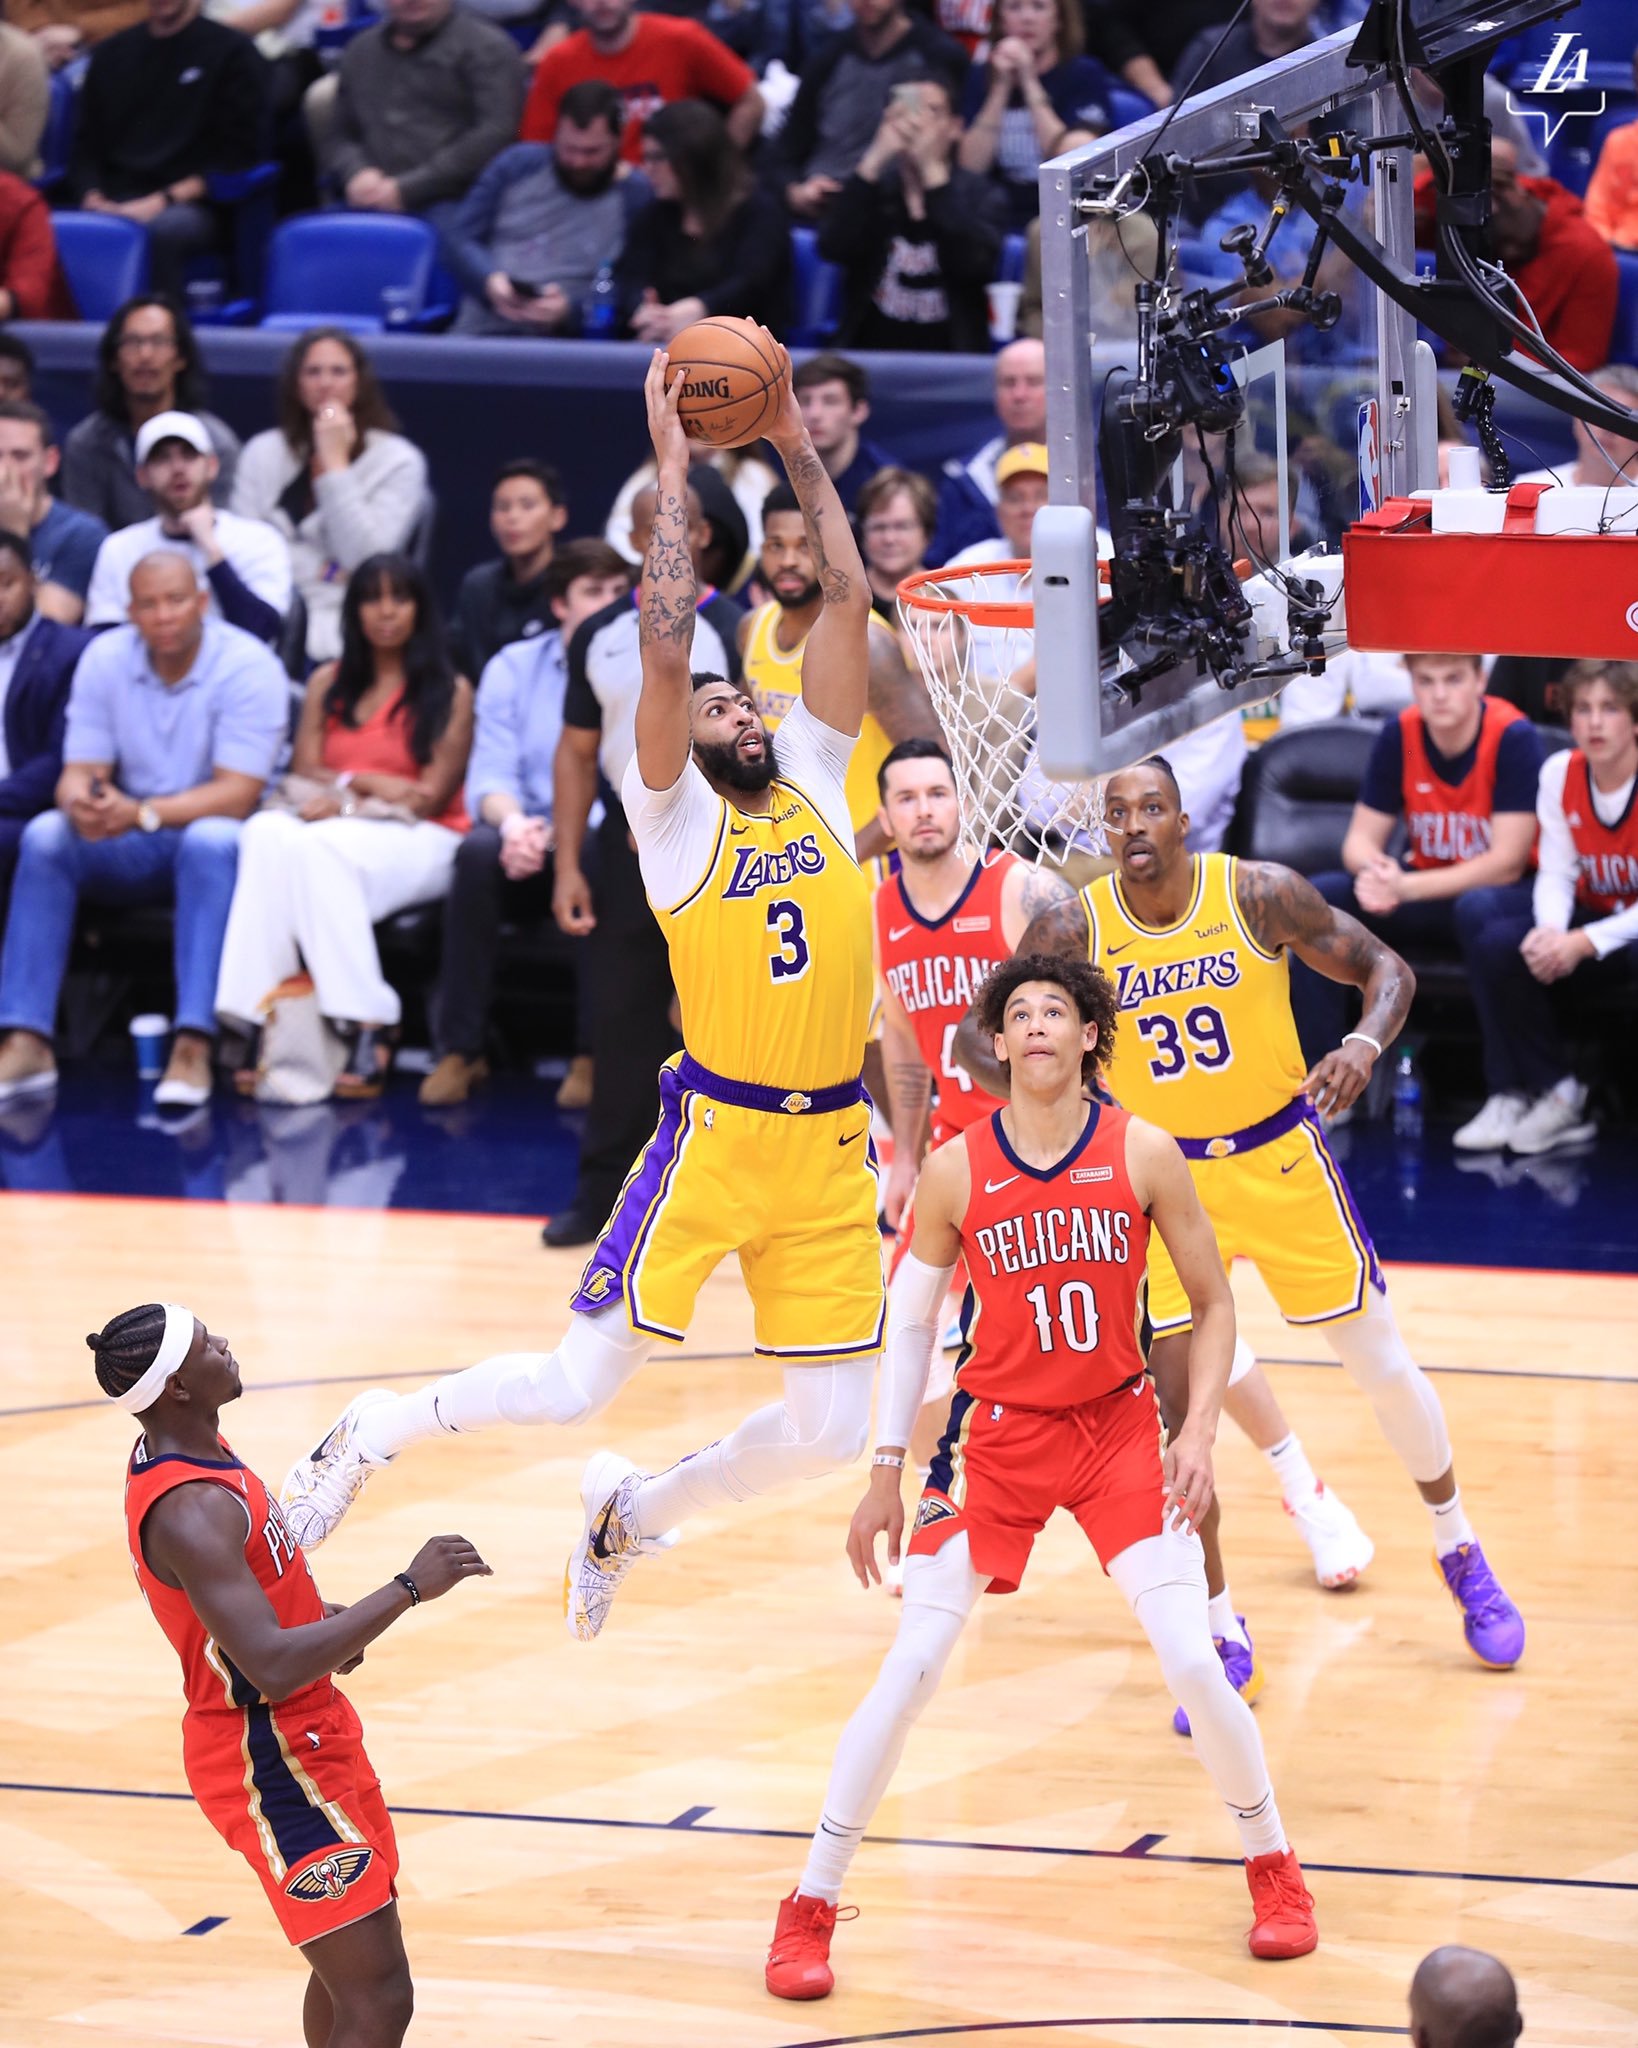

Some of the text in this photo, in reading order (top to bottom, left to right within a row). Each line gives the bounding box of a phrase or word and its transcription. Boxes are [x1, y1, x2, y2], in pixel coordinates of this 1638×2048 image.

[773, 803, 802, 824] wish
[721, 833, 826, 899] LAKERS
[766, 900, 812, 985] 3
[1194, 922, 1229, 939] wish
[886, 955, 1001, 1013] PELICAN
[1115, 950, 1241, 1011] LAKERS
[1136, 1004, 1234, 1084] 39
[975, 1206, 1131, 1276] PELICANS
[1025, 1280, 1099, 1353] 10
